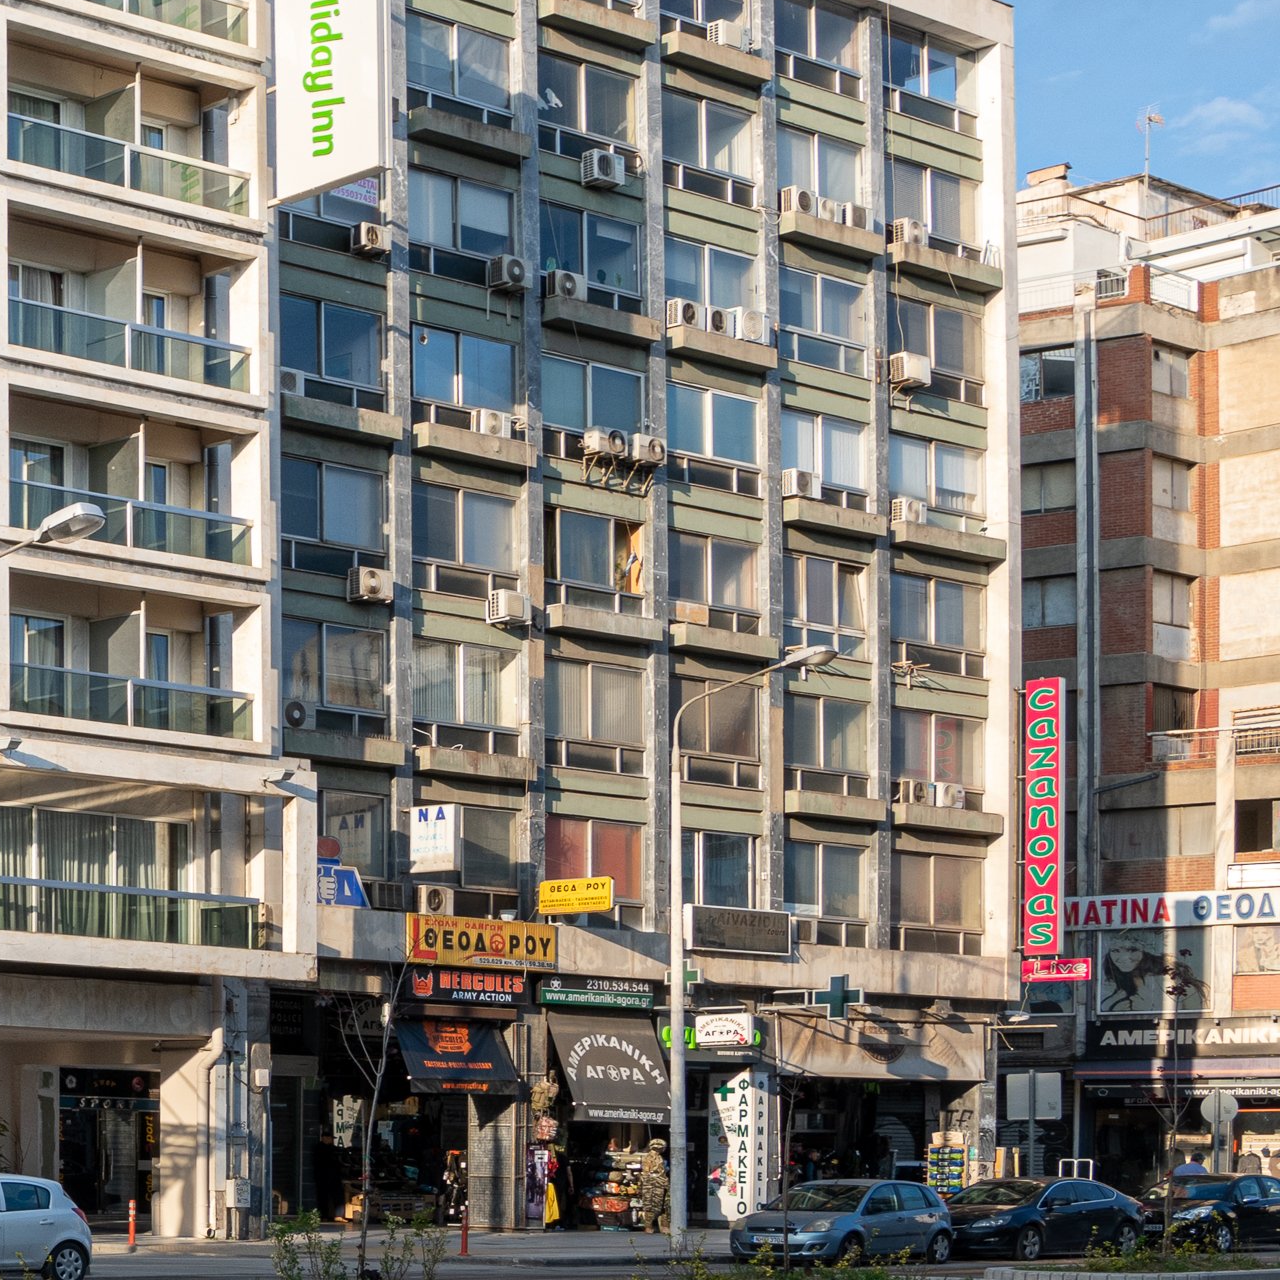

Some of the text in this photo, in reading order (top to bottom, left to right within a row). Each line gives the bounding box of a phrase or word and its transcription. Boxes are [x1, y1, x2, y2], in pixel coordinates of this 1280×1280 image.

[311, 96, 346, 158] Inn
[1027, 687, 1057, 946] cazanovas
[424, 918, 458, 928] ΣΧΟΛΗ
[1032, 961, 1088, 975] Live
[440, 970, 524, 993] HERCULES
[586, 979, 649, 992] 2310.534.544
[452, 990, 512, 1002] ARMY ACTION
[546, 991, 650, 1007] www.amerikaniki-agora.gr
[566, 1034, 665, 1085] ΑΜΕΡΙΚΑΝΙΚΗ
[588, 1109, 664, 1122] www.amerikaniki-agora.gr
[737, 1078, 750, 1215] ΦΑΡΜΑΚΕΙΟ
